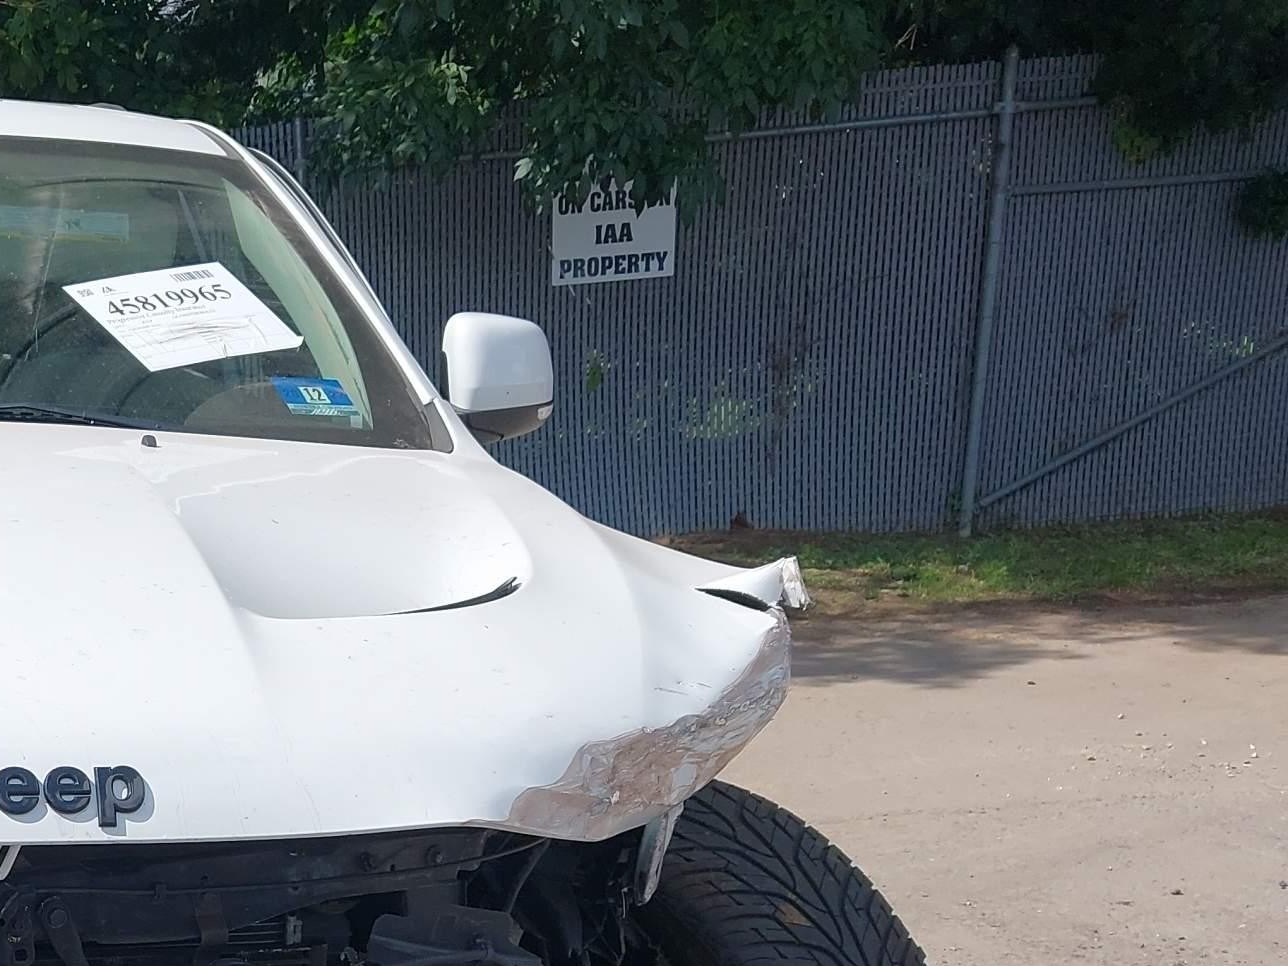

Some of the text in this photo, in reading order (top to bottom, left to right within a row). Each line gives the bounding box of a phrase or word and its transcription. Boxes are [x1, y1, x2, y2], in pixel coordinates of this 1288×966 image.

[595, 222, 633, 244] IAA
[559, 251, 668, 279] PROPERTY
[108, 284, 232, 316] 45819965
[303, 387, 327, 402] 12
